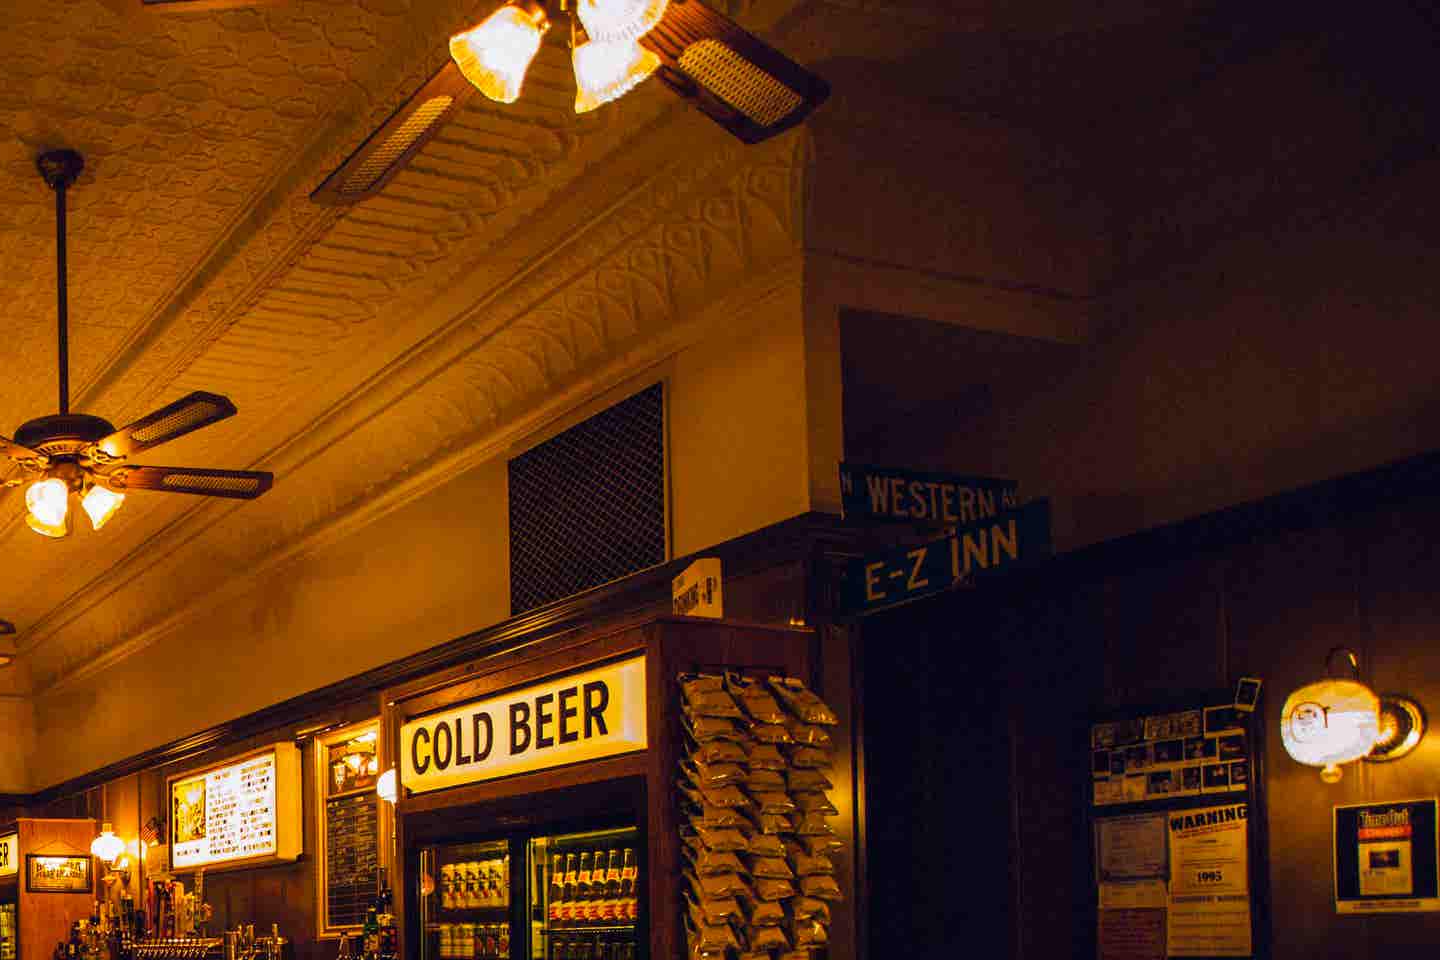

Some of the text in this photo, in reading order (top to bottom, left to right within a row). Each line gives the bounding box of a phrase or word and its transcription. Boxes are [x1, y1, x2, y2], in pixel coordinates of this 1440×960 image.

[864, 471, 997, 521] WESTERN
[864, 518, 1019, 601] E-Z INN
[412, 680, 610, 776] COLD BEER
[1170, 804, 1248, 831] WARNING
